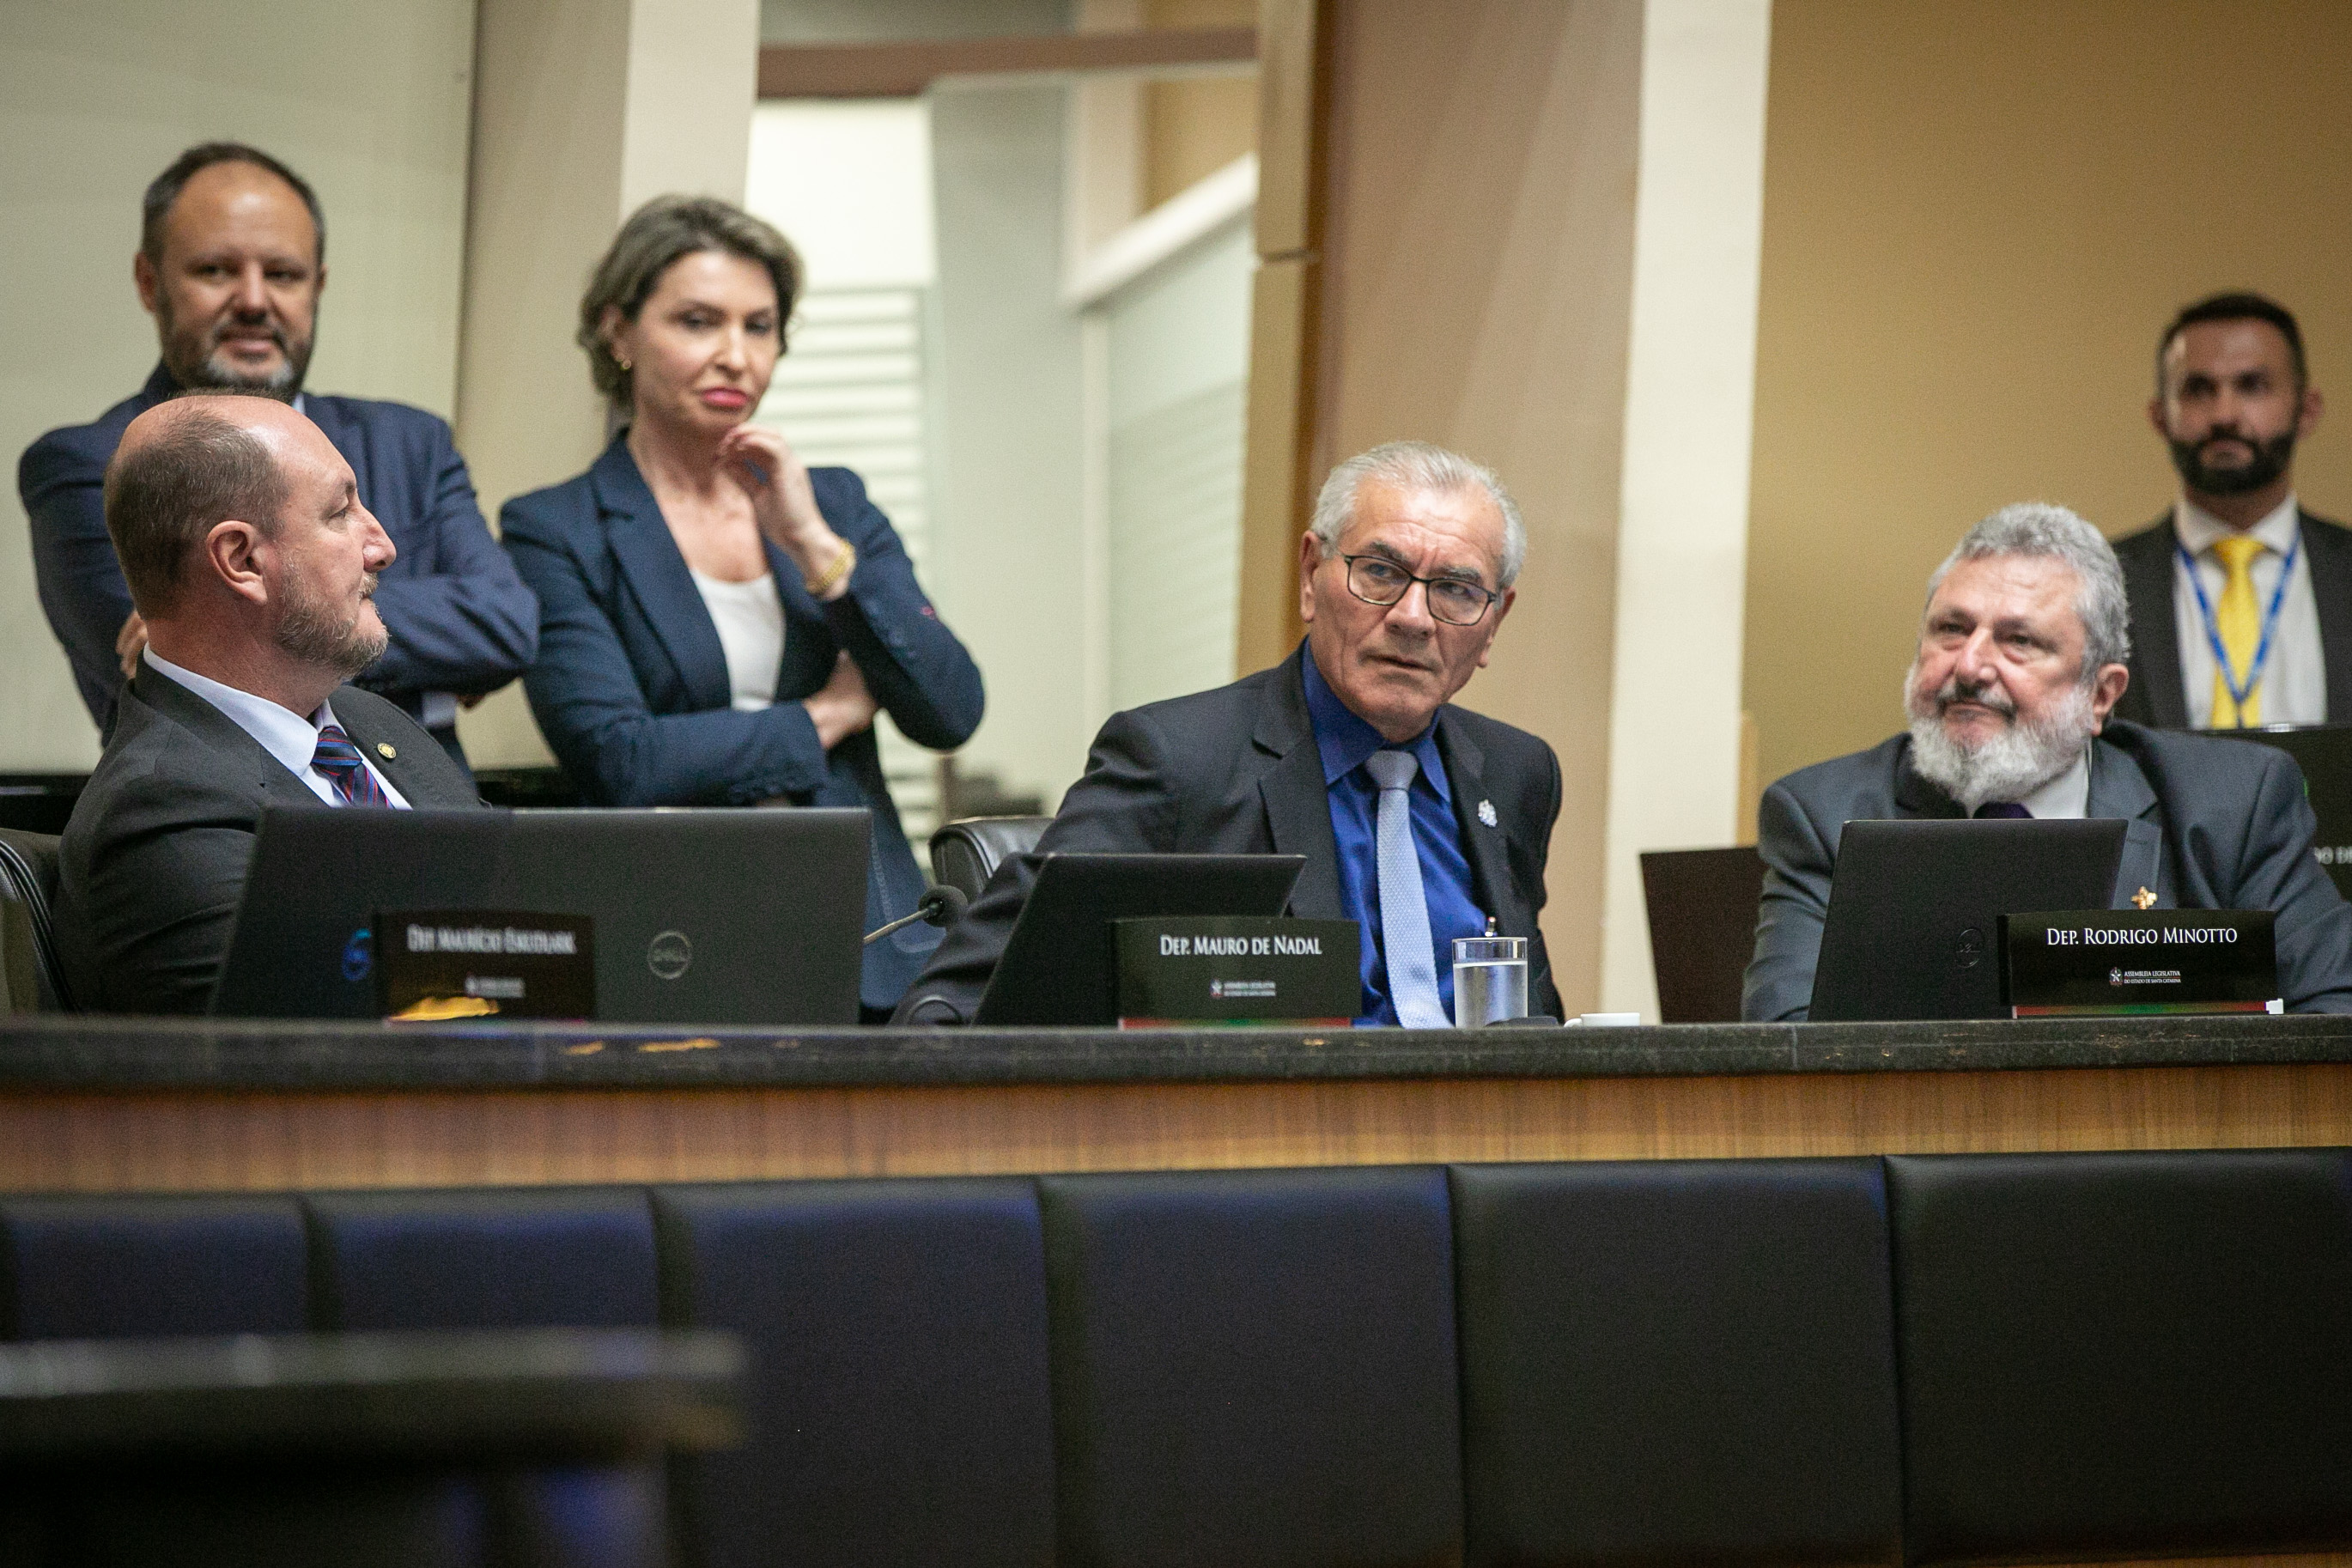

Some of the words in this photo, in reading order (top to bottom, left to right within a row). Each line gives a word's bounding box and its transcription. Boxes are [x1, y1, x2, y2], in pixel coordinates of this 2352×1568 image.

[1160, 934, 1190, 956] DEP.
[1194, 936, 1248, 955] MAURO
[1251, 937, 1271, 955] DE
[1273, 935, 1322, 955] NADAL
[2046, 928, 2079, 945] DEP.
[2084, 927, 2158, 945] RODRIGO
[2163, 927, 2238, 944] MINOTTO
